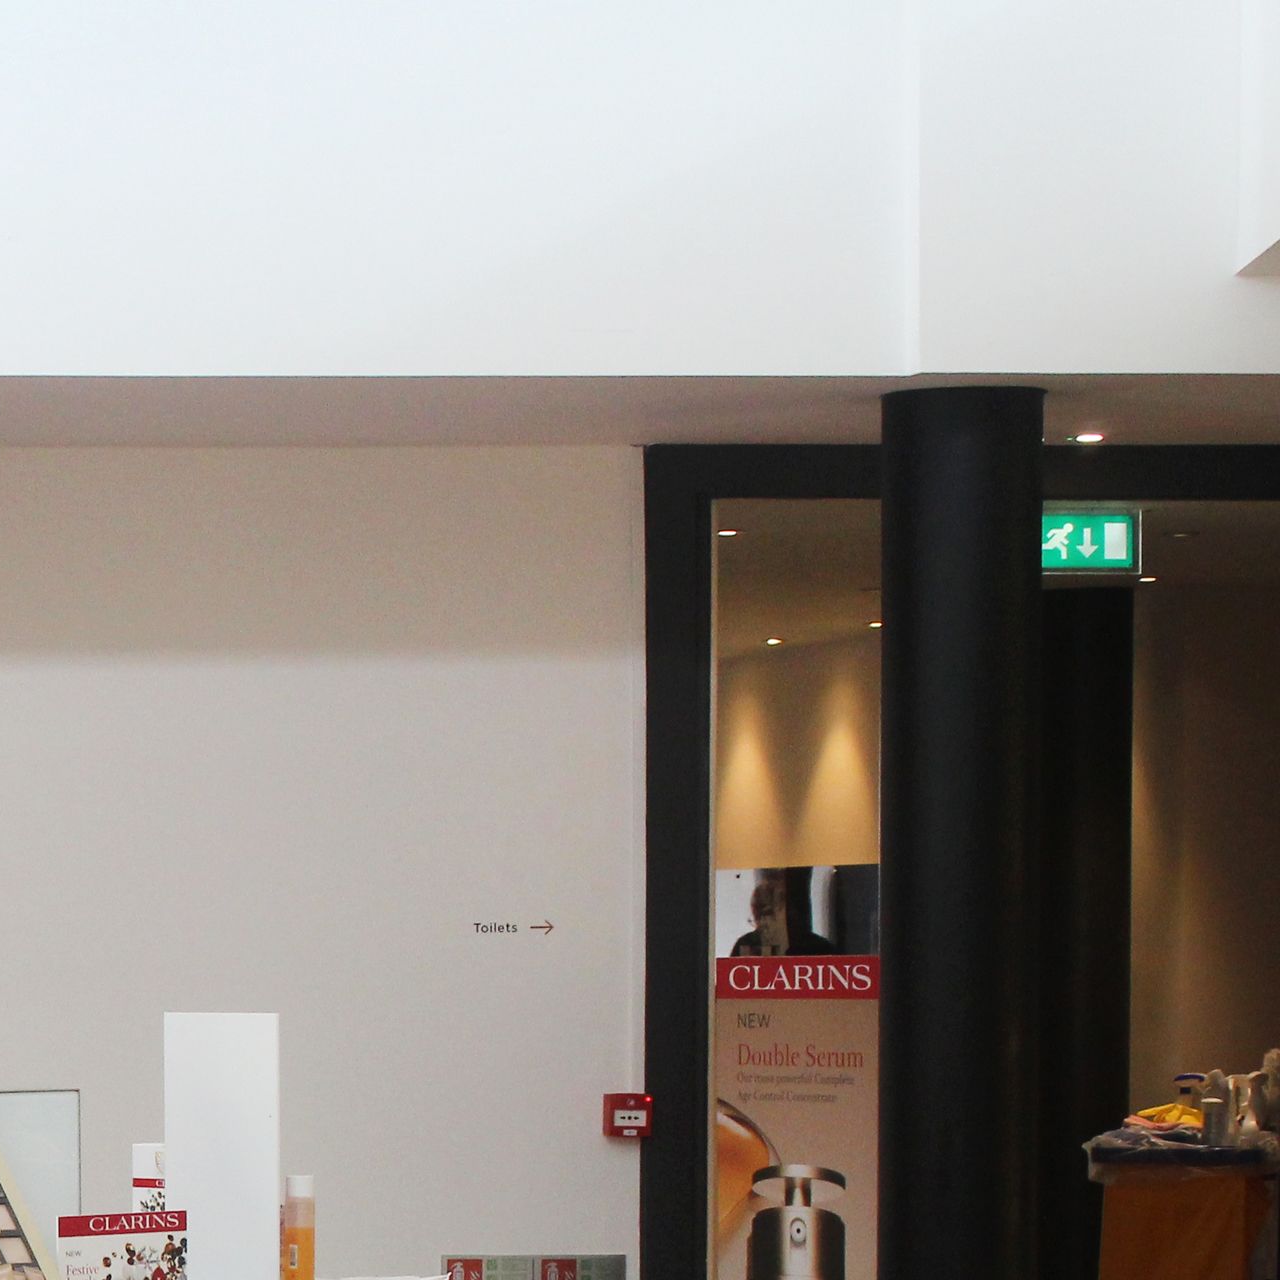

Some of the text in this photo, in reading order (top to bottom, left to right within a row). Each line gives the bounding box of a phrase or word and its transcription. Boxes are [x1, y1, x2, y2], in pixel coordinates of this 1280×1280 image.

[473, 922, 518, 934] Toilets
[728, 964, 872, 991] CLARINS
[736, 1013, 771, 1028] NEW
[738, 1042, 864, 1068] Double Serum
[89, 1213, 180, 1232] CLARINS
[66, 1264, 99, 1275] Festive
